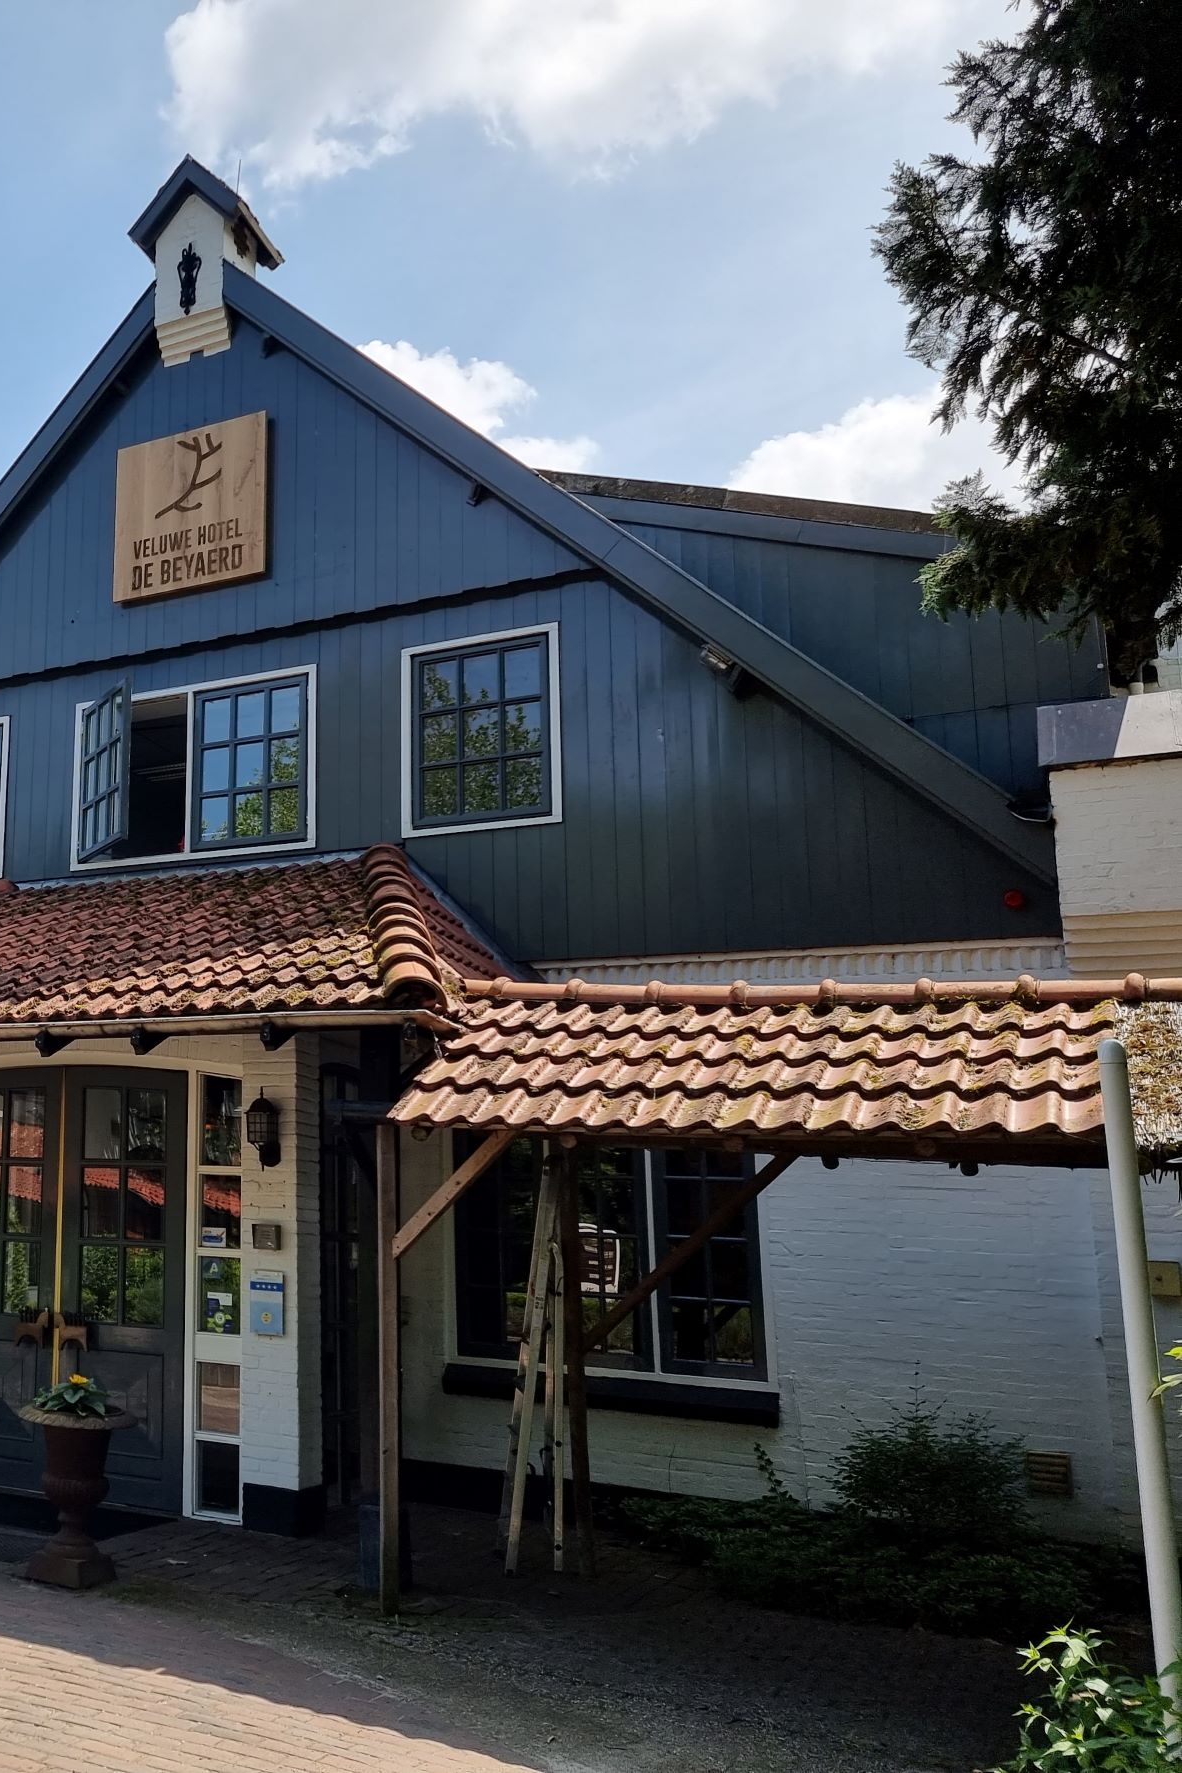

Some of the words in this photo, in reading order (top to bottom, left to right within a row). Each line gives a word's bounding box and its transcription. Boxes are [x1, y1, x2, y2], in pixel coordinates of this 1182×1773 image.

[133, 528, 192, 560] VELUWE
[197, 518, 243, 546] HOTEL
[132, 563, 153, 591] DE
[160, 544, 245, 585] BEYAERD
[209, 1262, 219, 1274] A
